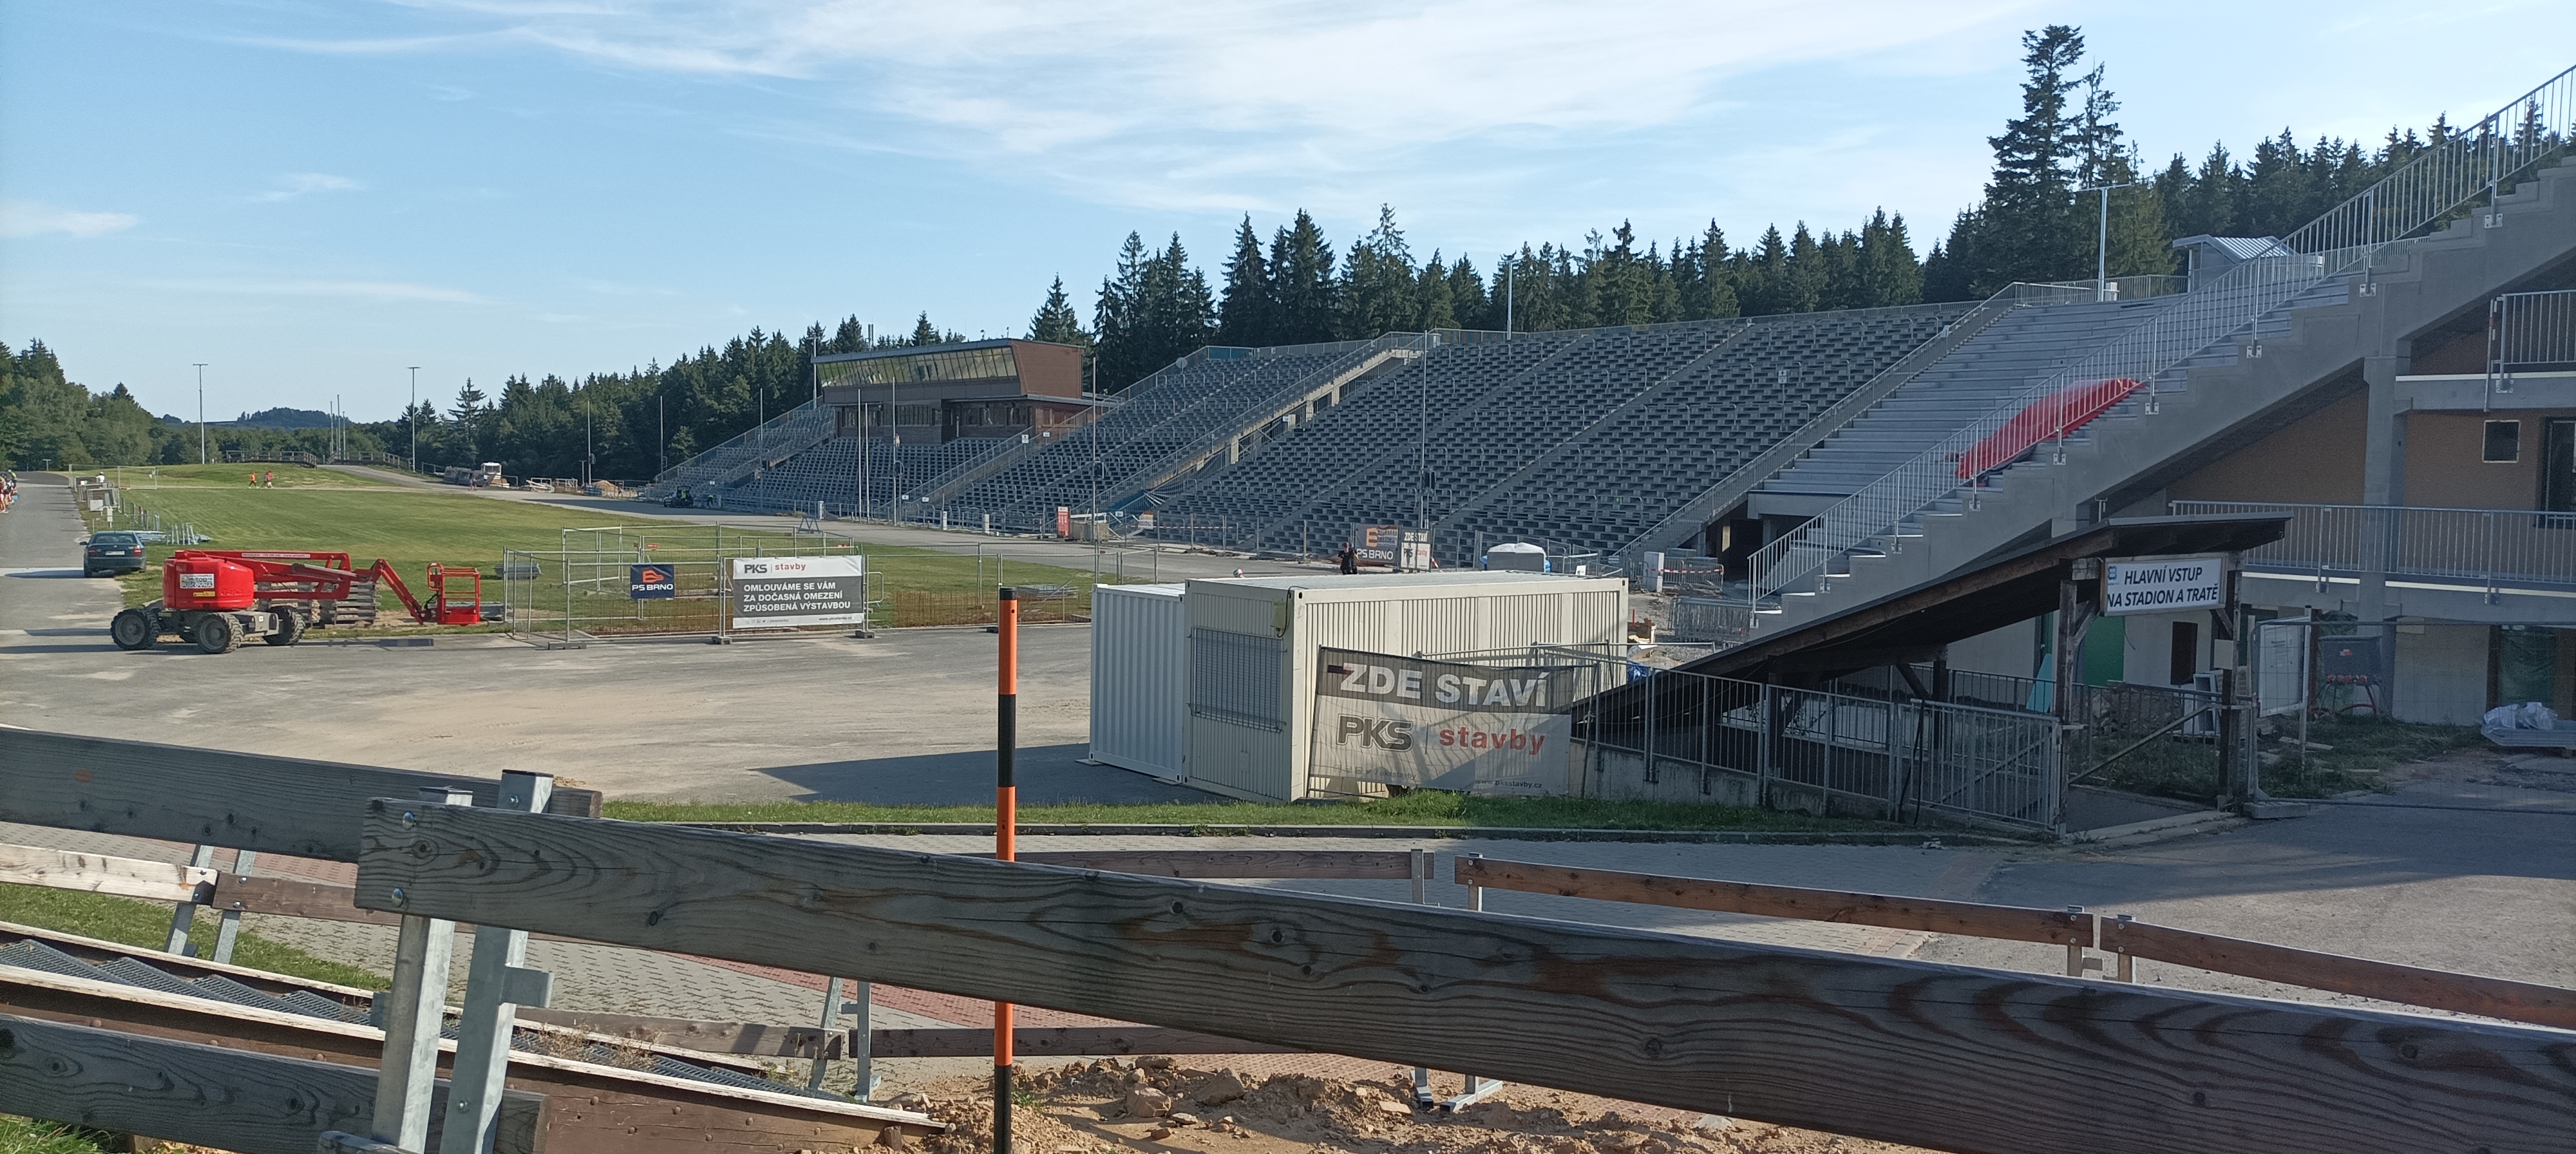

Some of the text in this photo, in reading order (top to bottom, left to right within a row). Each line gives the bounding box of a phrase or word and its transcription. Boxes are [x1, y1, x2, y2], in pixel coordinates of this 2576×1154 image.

[1404, 531, 1414, 541] ZDE
[1357, 549, 1394, 560] PS BRNO
[744, 563, 806, 574] PKS stavby
[2124, 565, 2202, 585] HLAVNÍ VSTUP
[743, 582, 801, 592] OMLOUVÁME
[817, 581, 836, 590] VÁM
[758, 592, 801, 601] DOČASNÁ
[803, 590, 842, 600] OMEZENÍ
[2107, 583, 2219, 607] NA STADION A TRATĚ
[743, 601, 851, 612] ZPŮSOBENÁ VÝSTAVBOU
[1340, 662, 1550, 707] ZDE STAVÍ
[1336, 713, 1546, 755] PKS stavby
[1379, 770, 1416, 780] pksstavby
[1475, 779, 1542, 789] www.pksstavby.cz
